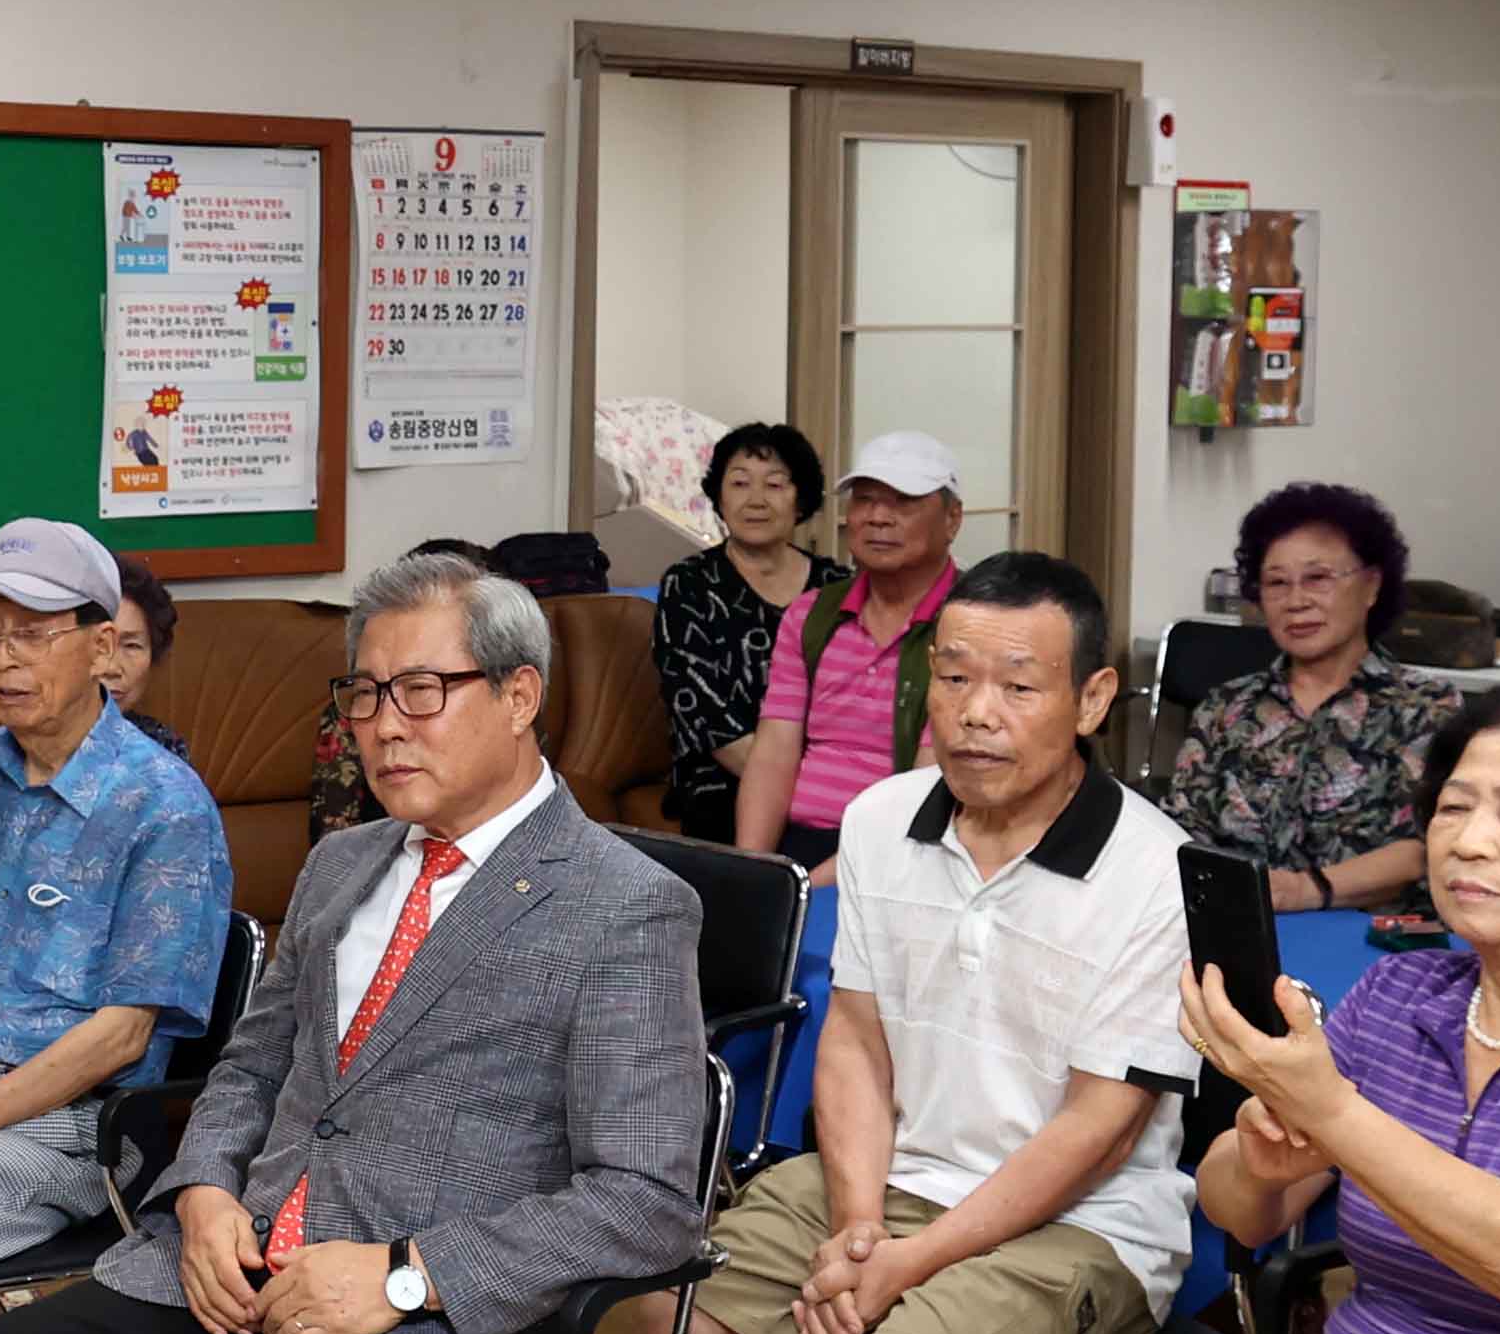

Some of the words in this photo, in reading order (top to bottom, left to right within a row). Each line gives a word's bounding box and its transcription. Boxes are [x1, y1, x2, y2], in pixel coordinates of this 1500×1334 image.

[434, 136, 457, 172] 9
[150, 176, 177, 194] 조심!
[376, 197, 384, 218] 1
[397, 197, 407, 215] 2
[417, 197, 427, 215] 3
[437, 198, 448, 216] 4
[461, 198, 473, 217] 5
[488, 199, 500, 217] 6
[515, 200, 526, 219] 7
[375, 232, 385, 251] 8
[396, 232, 406, 251] 9
[413, 233, 429, 251] 10
[435, 233, 450, 252] 11
[457, 233, 475, 252] 12
[483, 234, 502, 253] 13
[509, 234, 528, 254] 14
[371, 267, 386, 286] 15
[391, 268, 407, 286] 16
[412, 268, 428, 286] 17
[434, 268, 450, 286] 18
[456, 268, 474, 287] 19
[479, 269, 501, 287] 20
[507, 269, 526, 288] 21
[241, 286, 267, 303] 조심!
[368, 303, 386, 322] 22
[388, 303, 407, 321] 23
[410, 303, 428, 321] 24
[432, 303, 450, 321] 25
[455, 303, 475, 321] 26
[479, 303, 499, 321] 27
[504, 303, 526, 322] 28
[367, 338, 385, 357] 29
[387, 338, 406, 356] 30
[152, 394, 179, 411] 조심!
[389, 418, 478, 440] 송림중앙신협
[119, 471, 160, 487] 낙상사고
